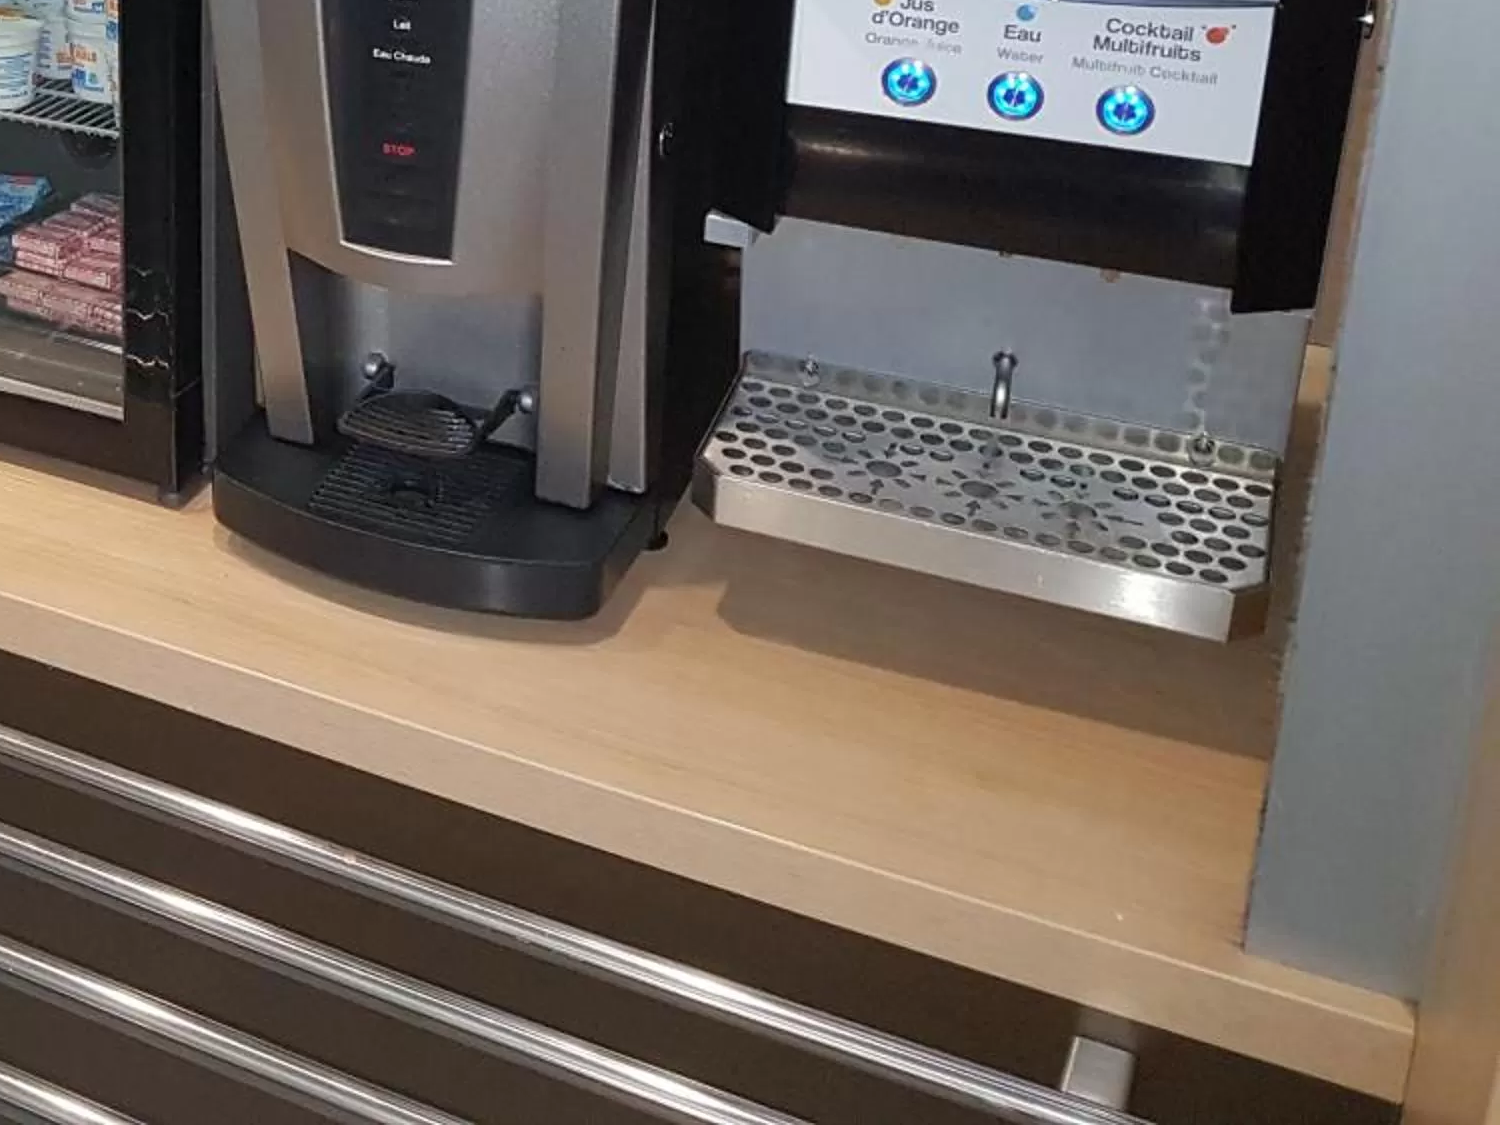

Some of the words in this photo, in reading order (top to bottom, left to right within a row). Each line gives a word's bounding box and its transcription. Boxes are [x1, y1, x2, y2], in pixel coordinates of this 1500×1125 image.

[871, 10, 960, 36] d'Orange
[1003, 24, 1042, 43] Eau
[1106, 17, 1195, 43] Cocktail
[997, 46, 1044, 64] Water
[1092, 34, 1202, 62] Multifruits
[383, 142, 415, 156] STOP
